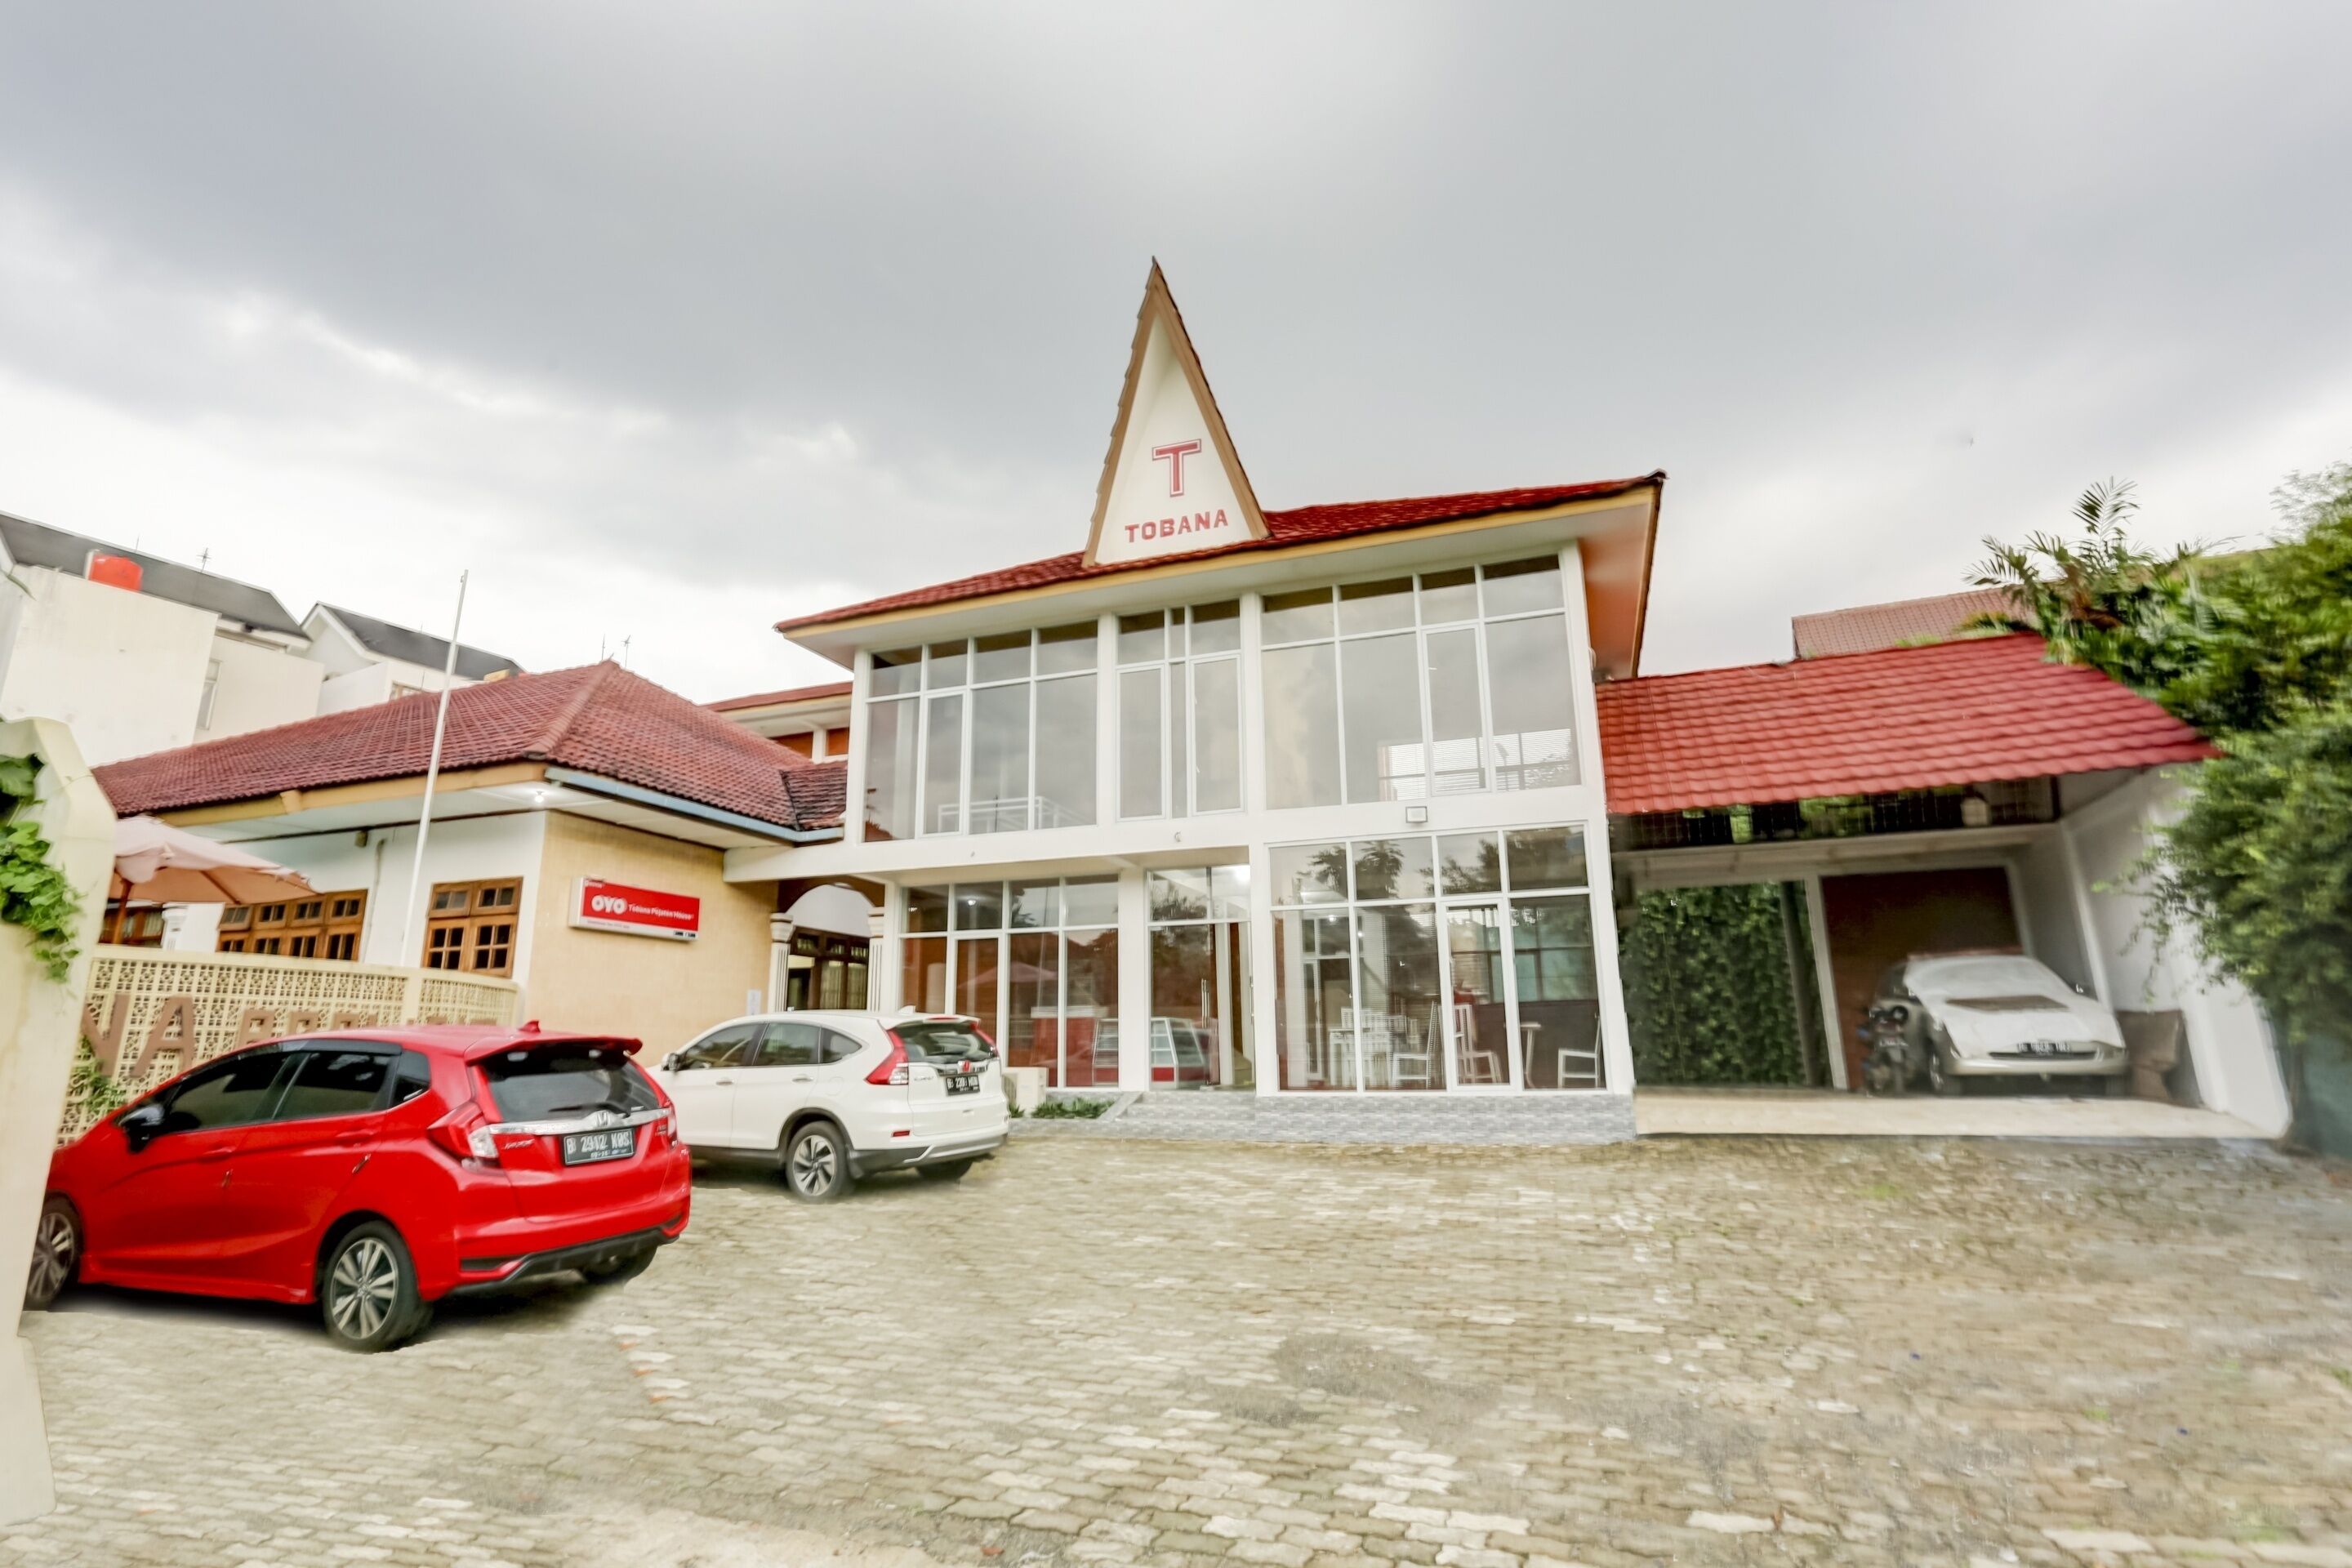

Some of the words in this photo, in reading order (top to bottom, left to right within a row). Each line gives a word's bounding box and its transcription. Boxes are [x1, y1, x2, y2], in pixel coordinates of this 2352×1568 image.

[1152, 439, 1201, 497] T
[1125, 509, 1228, 542] TOBANA
[591, 895, 627, 915] OYO
